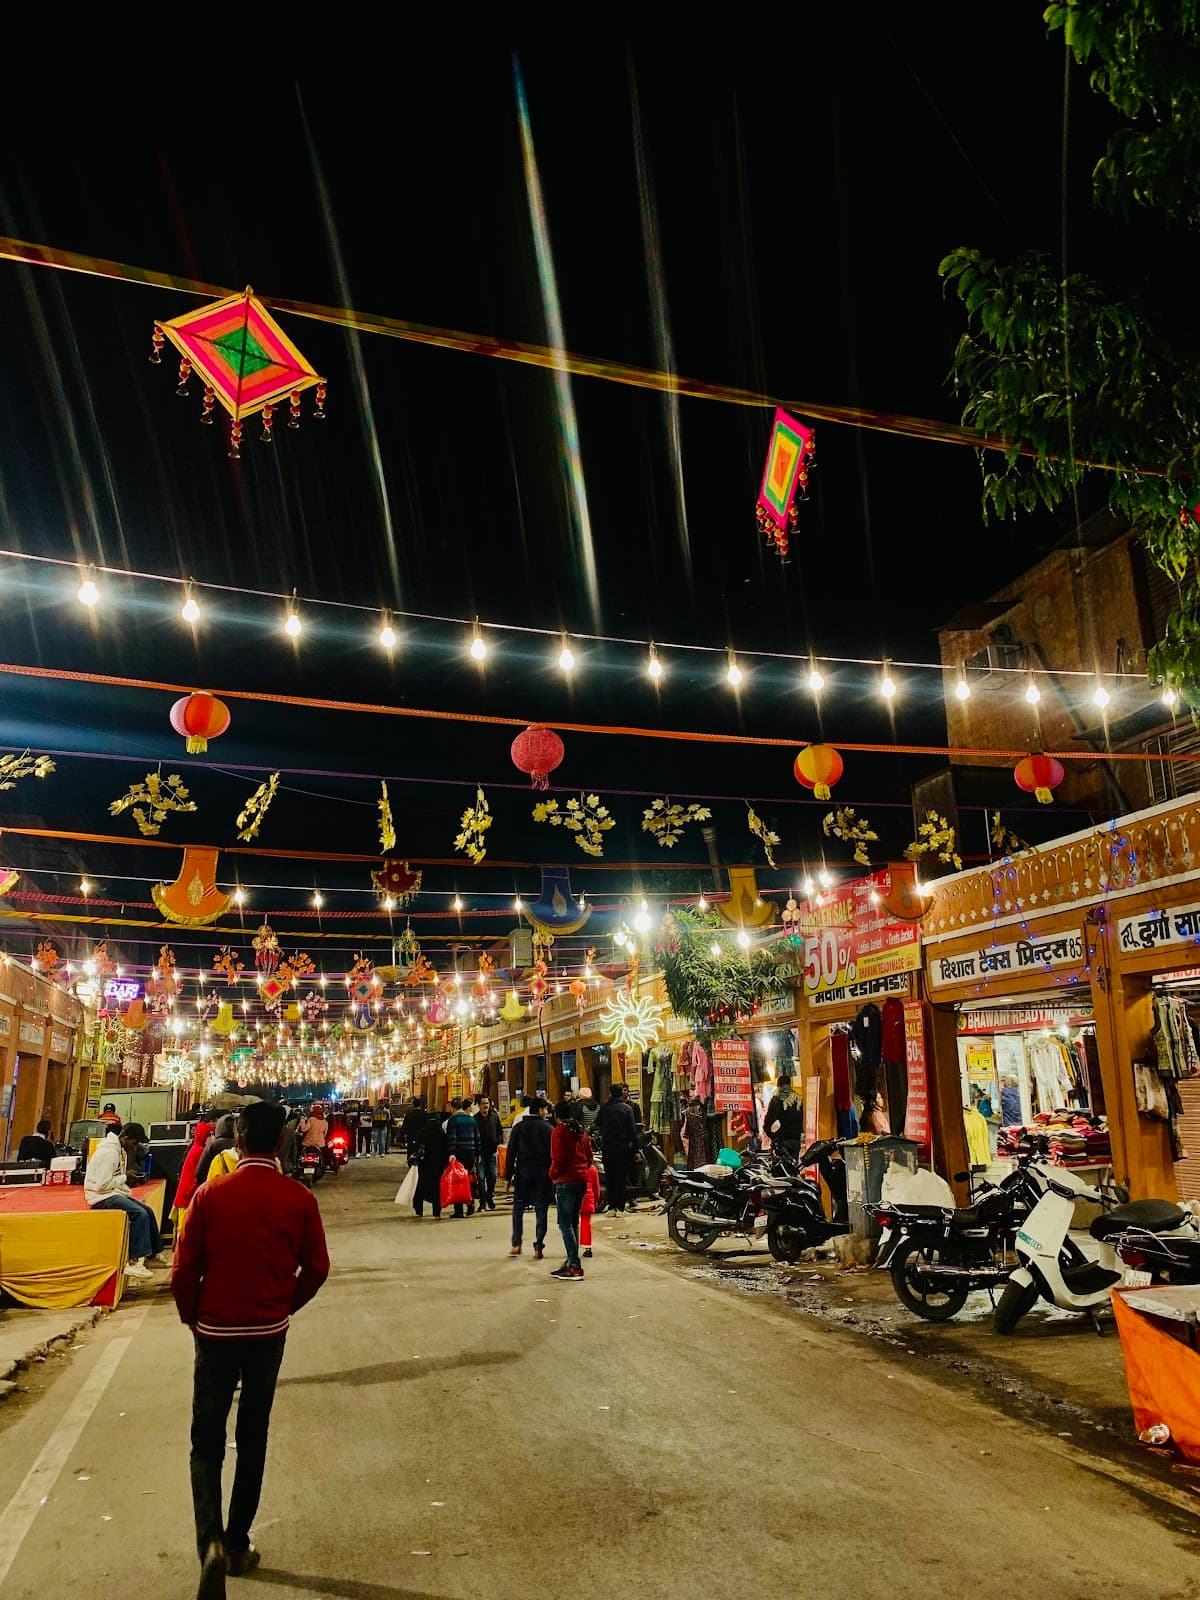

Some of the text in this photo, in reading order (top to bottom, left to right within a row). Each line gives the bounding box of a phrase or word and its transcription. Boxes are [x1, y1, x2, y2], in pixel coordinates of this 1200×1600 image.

[834, 898, 853, 923] SALE
[1138, 909, 1171, 948] दुर्गा
[1174, 911, 1200, 936] सा
[1069, 936, 1082, 959] 85
[905, 1021, 922, 1037] SALE
[967, 1011, 1010, 1030] BHAWANI
[723, 1042, 746, 1052] OSWAL
